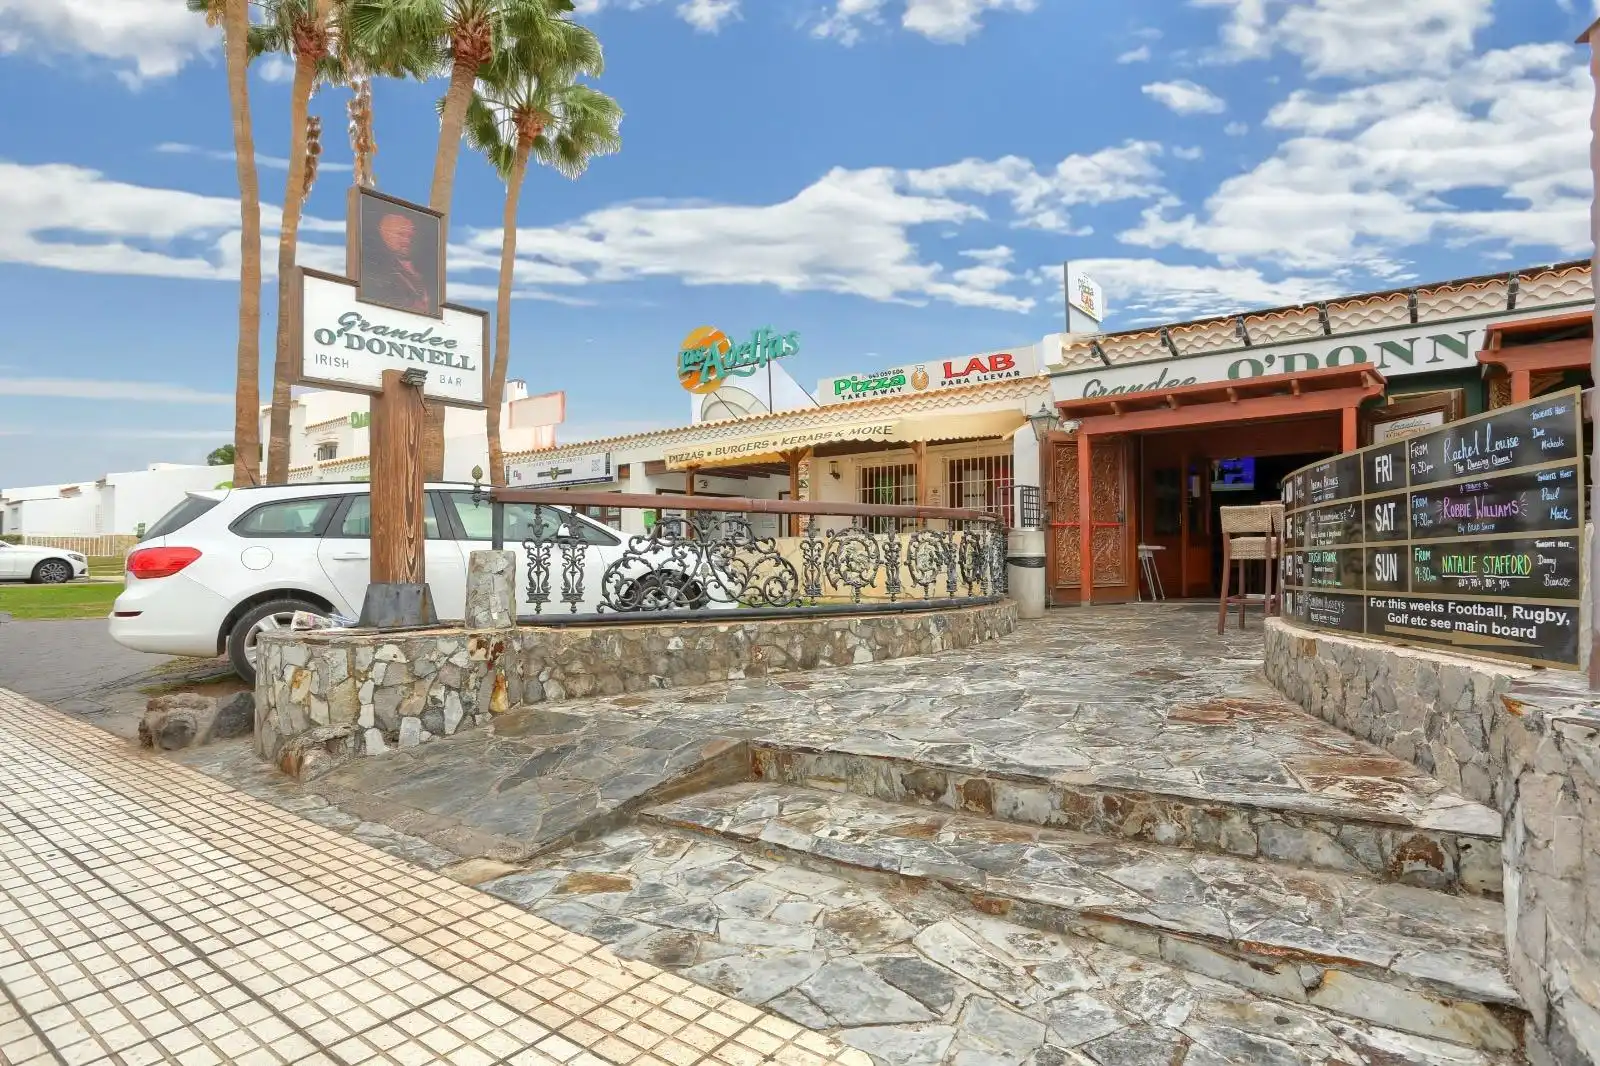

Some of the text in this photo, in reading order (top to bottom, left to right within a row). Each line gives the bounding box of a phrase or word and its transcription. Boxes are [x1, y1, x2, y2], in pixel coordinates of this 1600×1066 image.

[337, 311, 458, 349] Grandee
[314, 328, 476, 371] O'DONNELL
[315, 353, 349, 369] IRISH
[1227, 330, 1487, 380] O'DONN
[439, 374, 462, 387] BAR
[833, 353, 1016, 395] Pizza LAB
[940, 370, 1021, 387] PARA LLEVAR
[841, 386, 903, 401] TAKE AWAY
[668, 424, 893, 464] PIZZAS BURGERS KEBABS & MORE
[1375, 454, 1393, 484] FRI
[1375, 502, 1396, 532] SAT
[1443, 496, 1519, 519] ROBBIE WILLIAMS
[1375, 553, 1397, 581] SUN
[1442, 554, 1532, 576] NATALIE STAFFORD
[1370, 597, 1570, 626] For this weeks Football, Rugby,
[1387, 612, 1537, 639] Golf etc see main board
